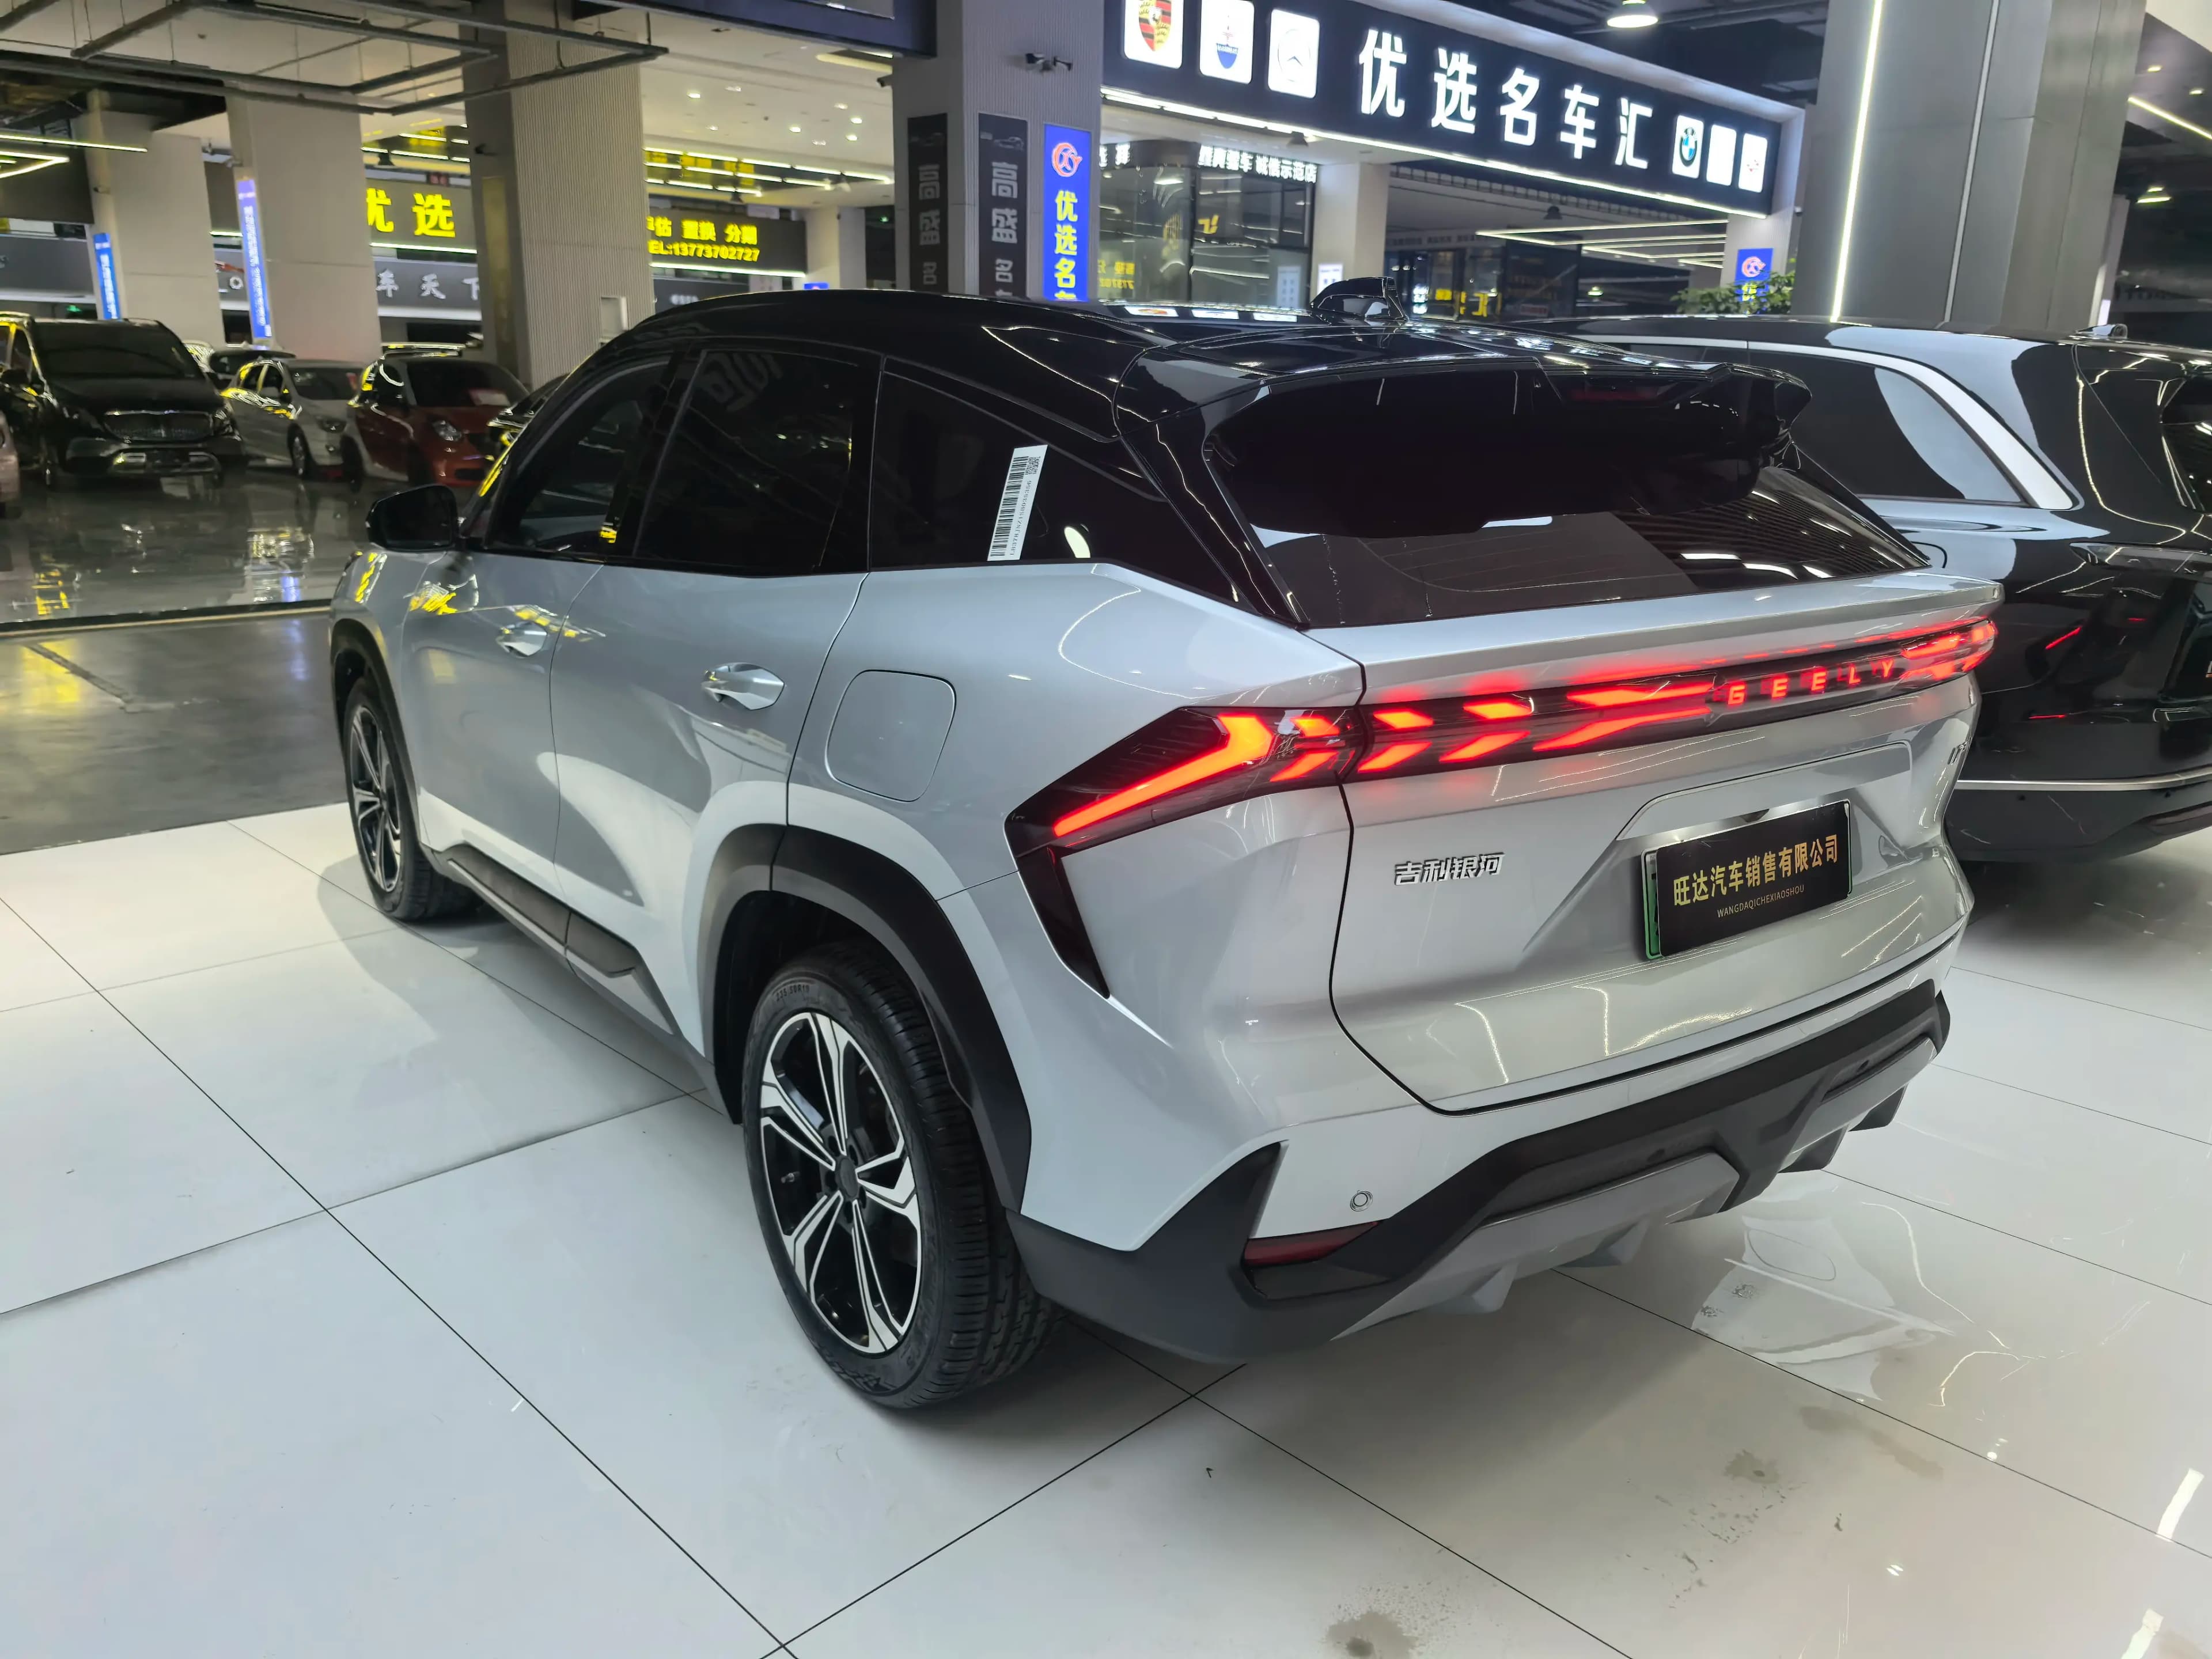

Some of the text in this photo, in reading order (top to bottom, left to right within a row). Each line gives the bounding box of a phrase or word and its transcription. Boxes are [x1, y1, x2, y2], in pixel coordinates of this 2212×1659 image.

[1359, 29, 1653, 169] 优选名车汇
[647, 239, 760, 262] EL:13773702727
[1728, 658, 1894, 706] GEELY
[1394, 851, 1506, 885] 吉利银河
[1673, 834, 1839, 906] 旺达汽车销售有限公司
[1717, 884, 1805, 918] WANGDAQICHEXIAOSHOU
